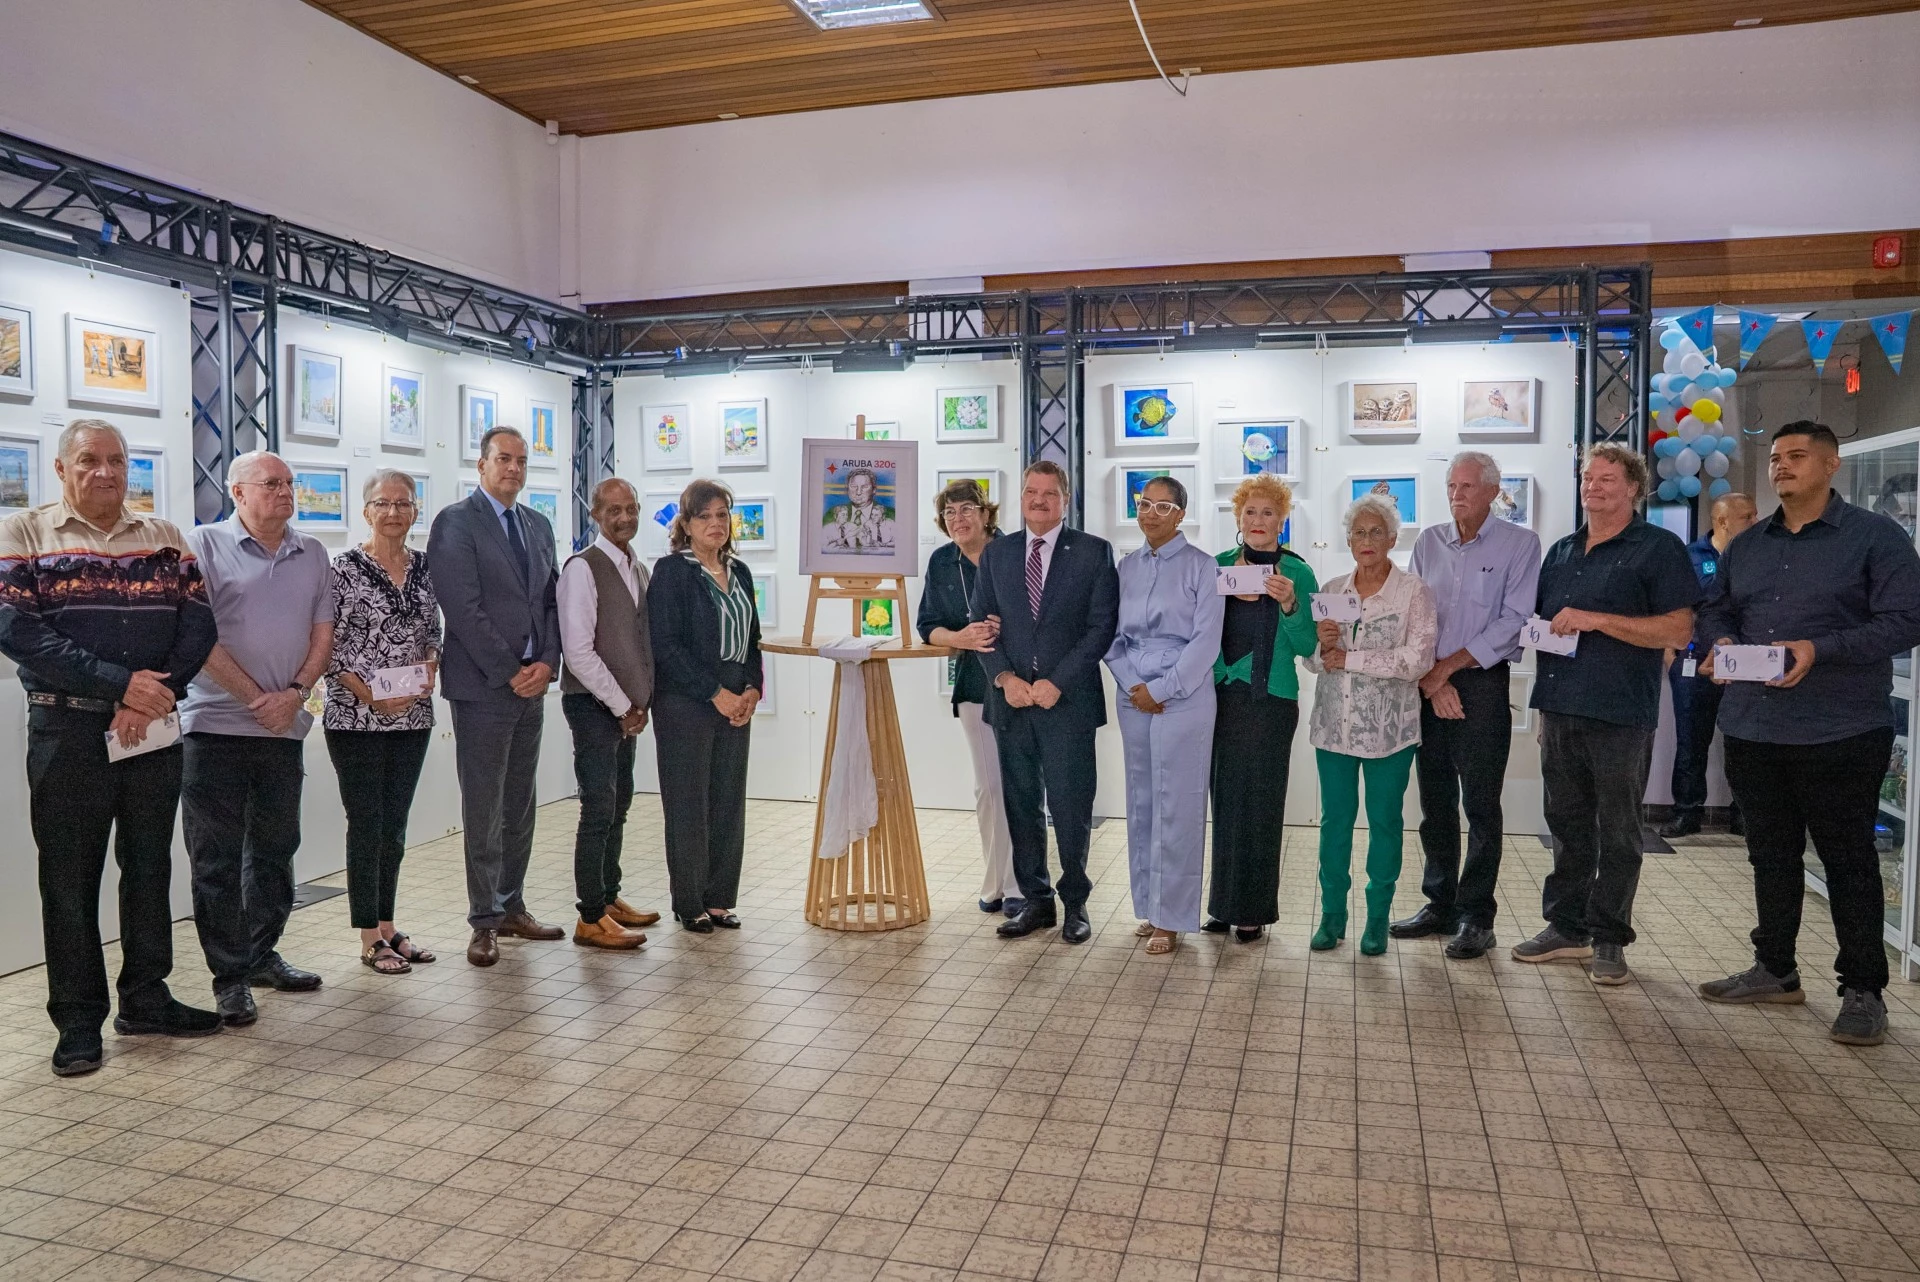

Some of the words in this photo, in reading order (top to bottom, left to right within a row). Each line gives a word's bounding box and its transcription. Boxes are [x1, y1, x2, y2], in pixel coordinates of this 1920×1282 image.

[842, 459, 873, 468] ARUBA
[874, 460, 896, 469] 320c
[1720, 653, 1737, 673] 40
